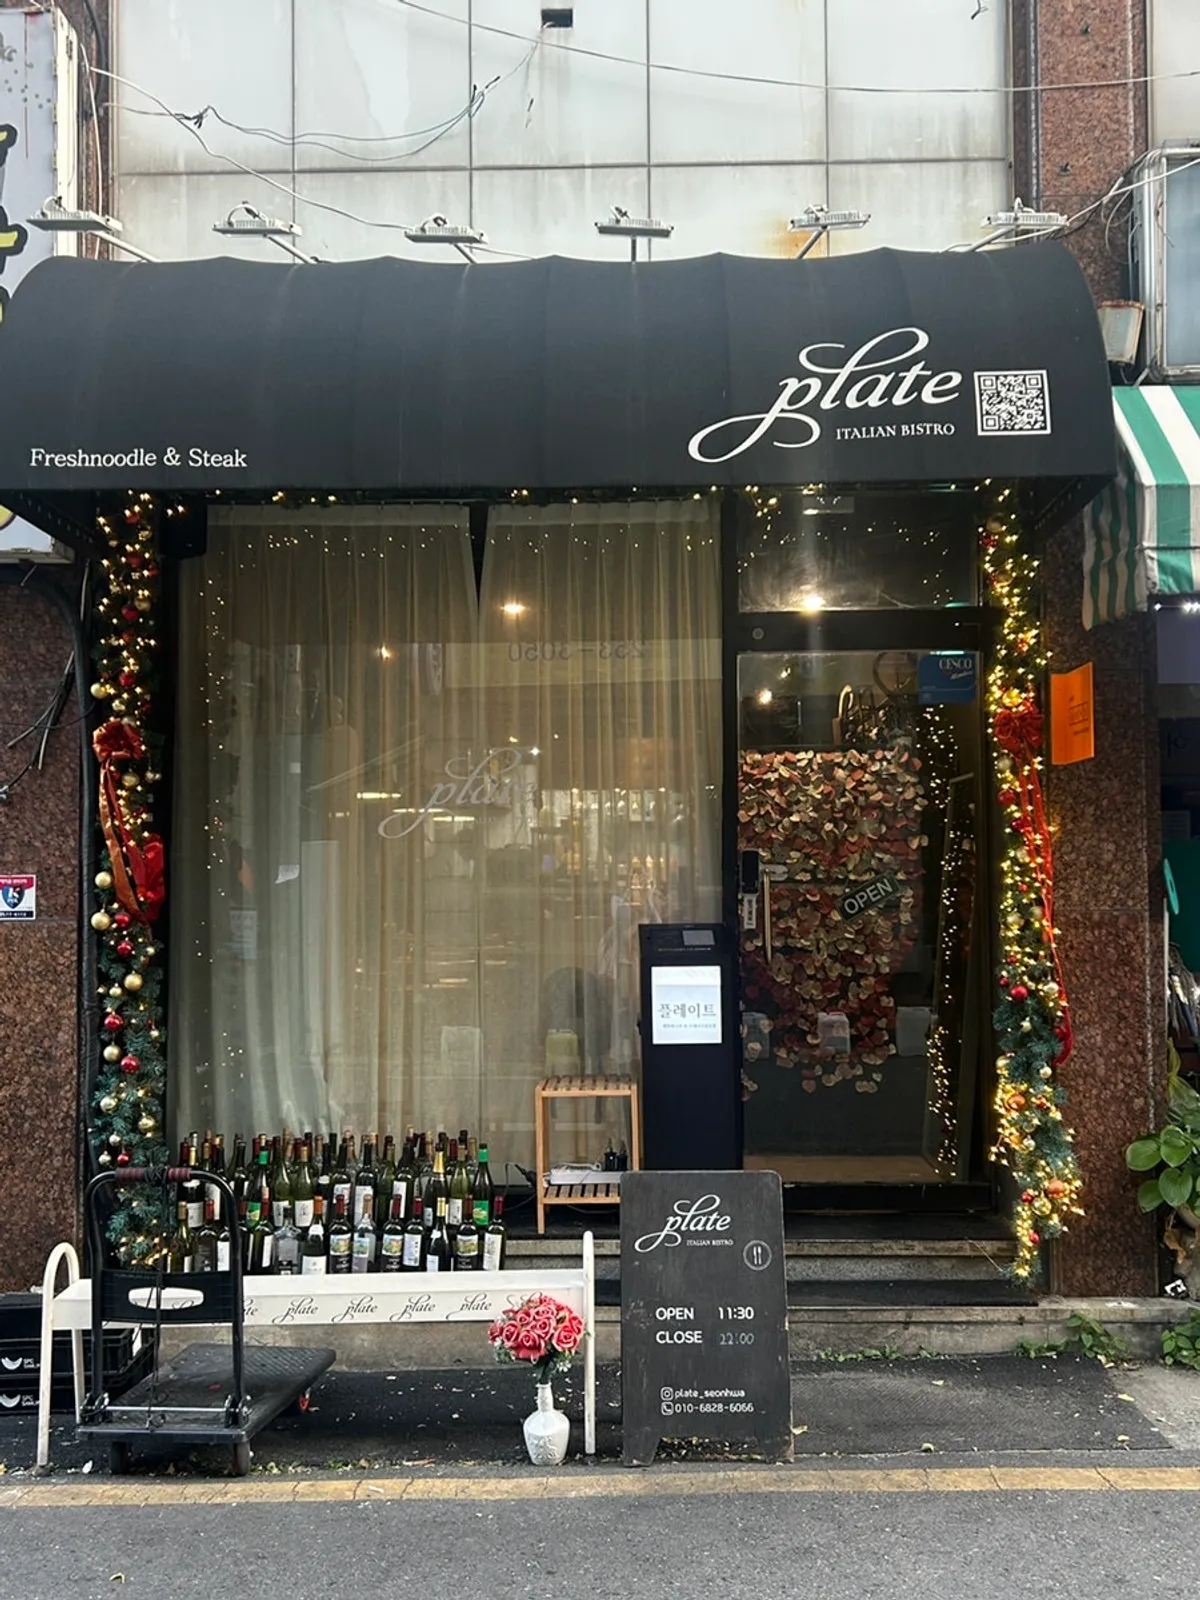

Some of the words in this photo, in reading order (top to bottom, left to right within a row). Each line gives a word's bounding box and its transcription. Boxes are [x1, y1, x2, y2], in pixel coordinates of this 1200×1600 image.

[687, 326, 963, 463] plate
[836, 425, 896, 440] ITALIAN
[901, 423, 955, 437] BISTRO
[30, 448, 156, 467] Freshnoodle
[163, 447, 181, 466] &
[188, 448, 247, 467] Steak
[844, 878, 893, 914] OPEN
[656, 1002, 717, 1019] 플레이트
[634, 1194, 731, 1253] plate
[272, 1296, 318, 1324] plate
[331, 1294, 378, 1323] plate
[390, 1293, 436, 1322] plate
[446, 1293, 492, 1320] plate
[655, 1307, 694, 1320] OPEN
[718, 1306, 754, 1320] 11:30
[655, 1331, 703, 1344] CLOSE
[720, 1333, 755, 1345] 22:00
[674, 1388, 745, 1399] plate_seonhwa
[674, 1402, 754, 1413] 010-6828-6066
